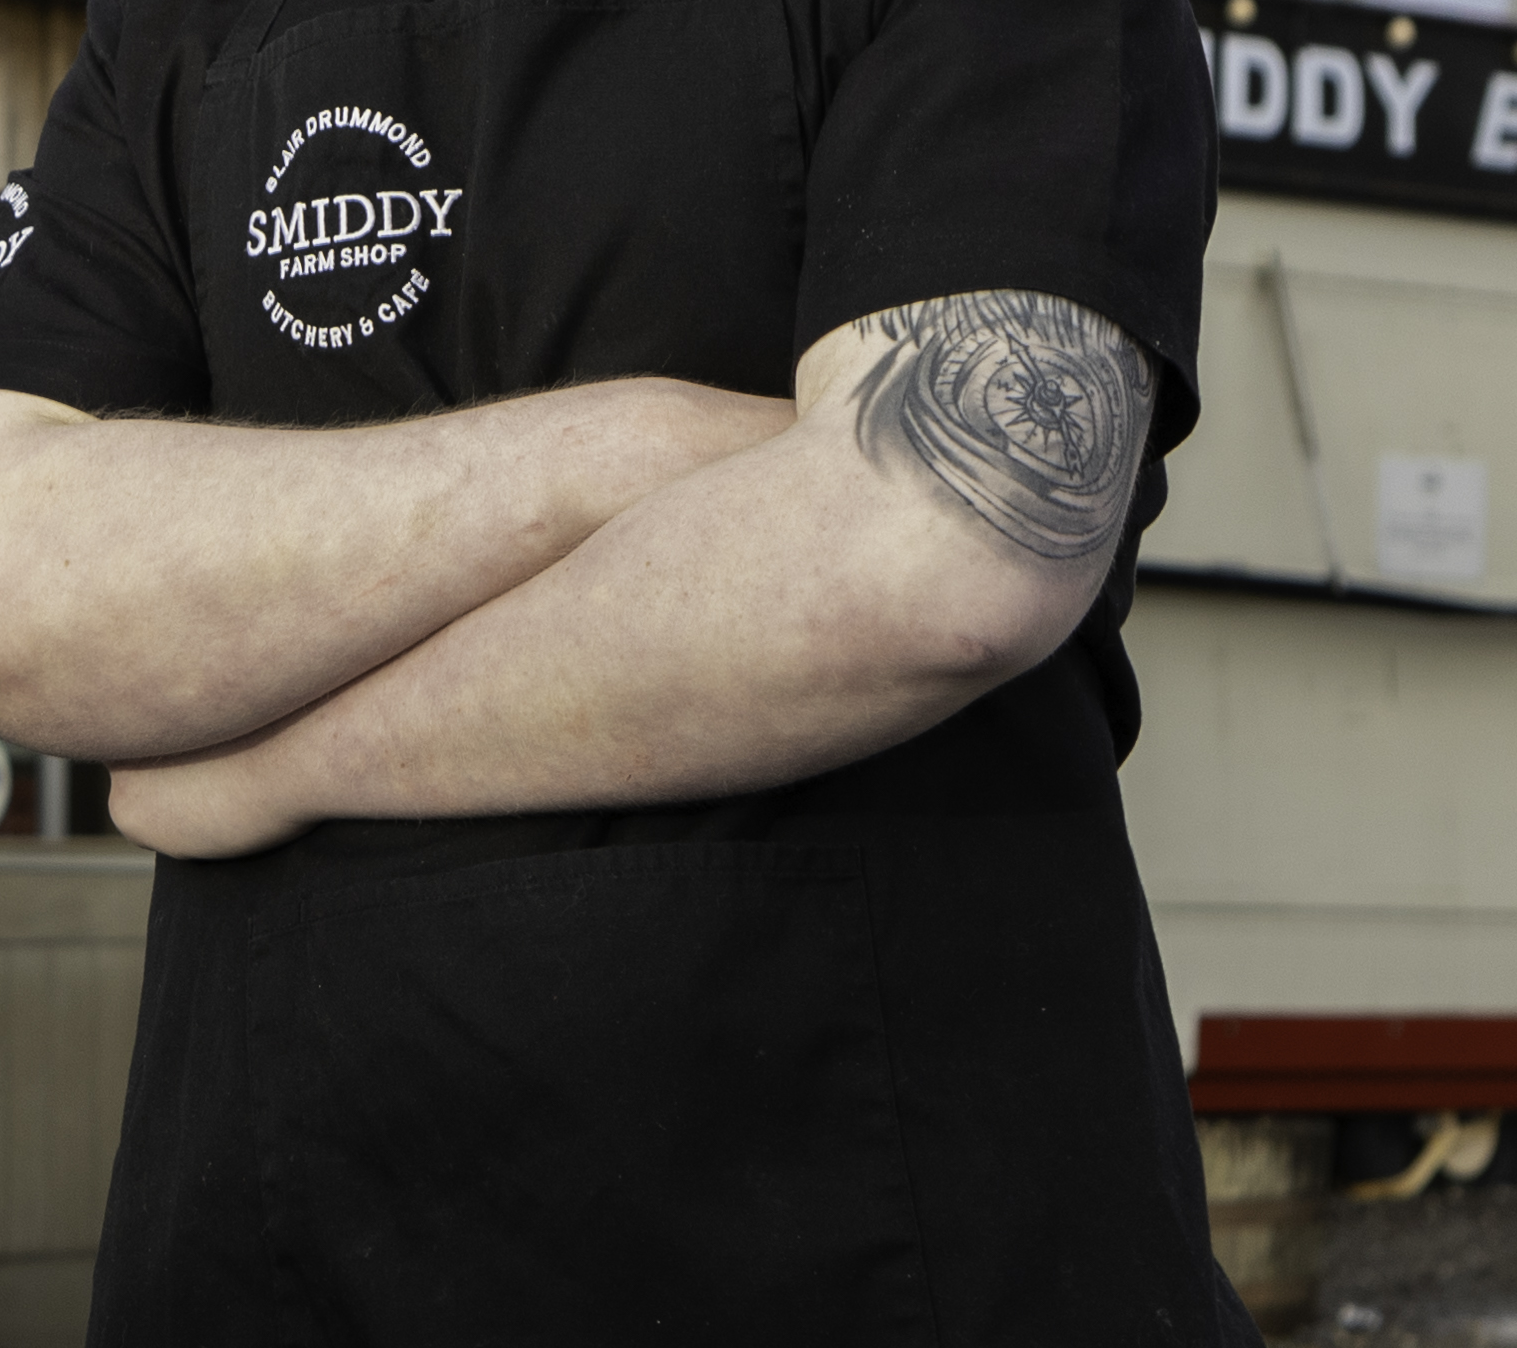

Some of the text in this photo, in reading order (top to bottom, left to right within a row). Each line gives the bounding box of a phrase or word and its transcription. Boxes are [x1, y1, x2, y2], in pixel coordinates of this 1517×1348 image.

[1199, 26, 1443, 160] DDY
[265, 106, 431, 193] BLAIR DRUMMOND
[246, 189, 462, 256] SMIDDY
[280, 244, 407, 279] FARM SHOP
[262, 290, 353, 347] BUTCHERY
[359, 317, 374, 336] &
